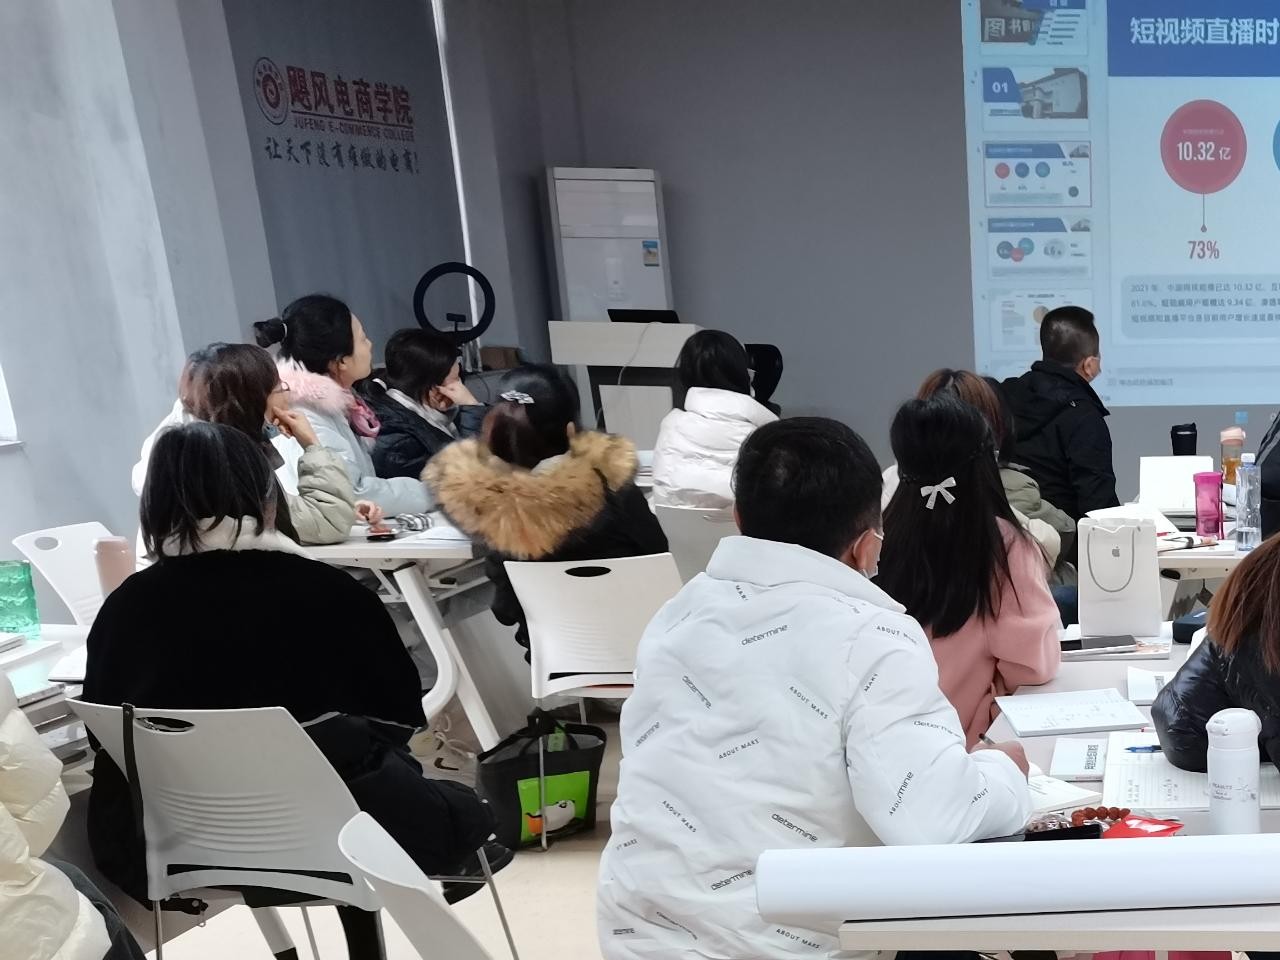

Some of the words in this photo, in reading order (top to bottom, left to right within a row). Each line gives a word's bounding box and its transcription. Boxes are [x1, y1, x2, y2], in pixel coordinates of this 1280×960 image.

[287, 65, 414, 125] 飓风电商学院
[992, 81, 1008, 93] 01
[1177, 141, 1215, 160] 10.32
[1218, 146, 1232, 161] 亿
[1187, 240, 1220, 259] 73%
[740, 624, 788, 647] determine
[876, 625, 901, 636] ABOUT
[789, 686, 809, 703] ABOUT
[810, 703, 829, 720] MARS
[718, 745, 740, 760] ABOUT
[662, 800, 681, 817] ABOUT
[681, 817, 697, 833] MARS
[771, 813, 818, 842] determine
[711, 869, 753, 891] determine
[776, 928, 801, 942] ABOUT
[801, 938, 821, 950] MARS
